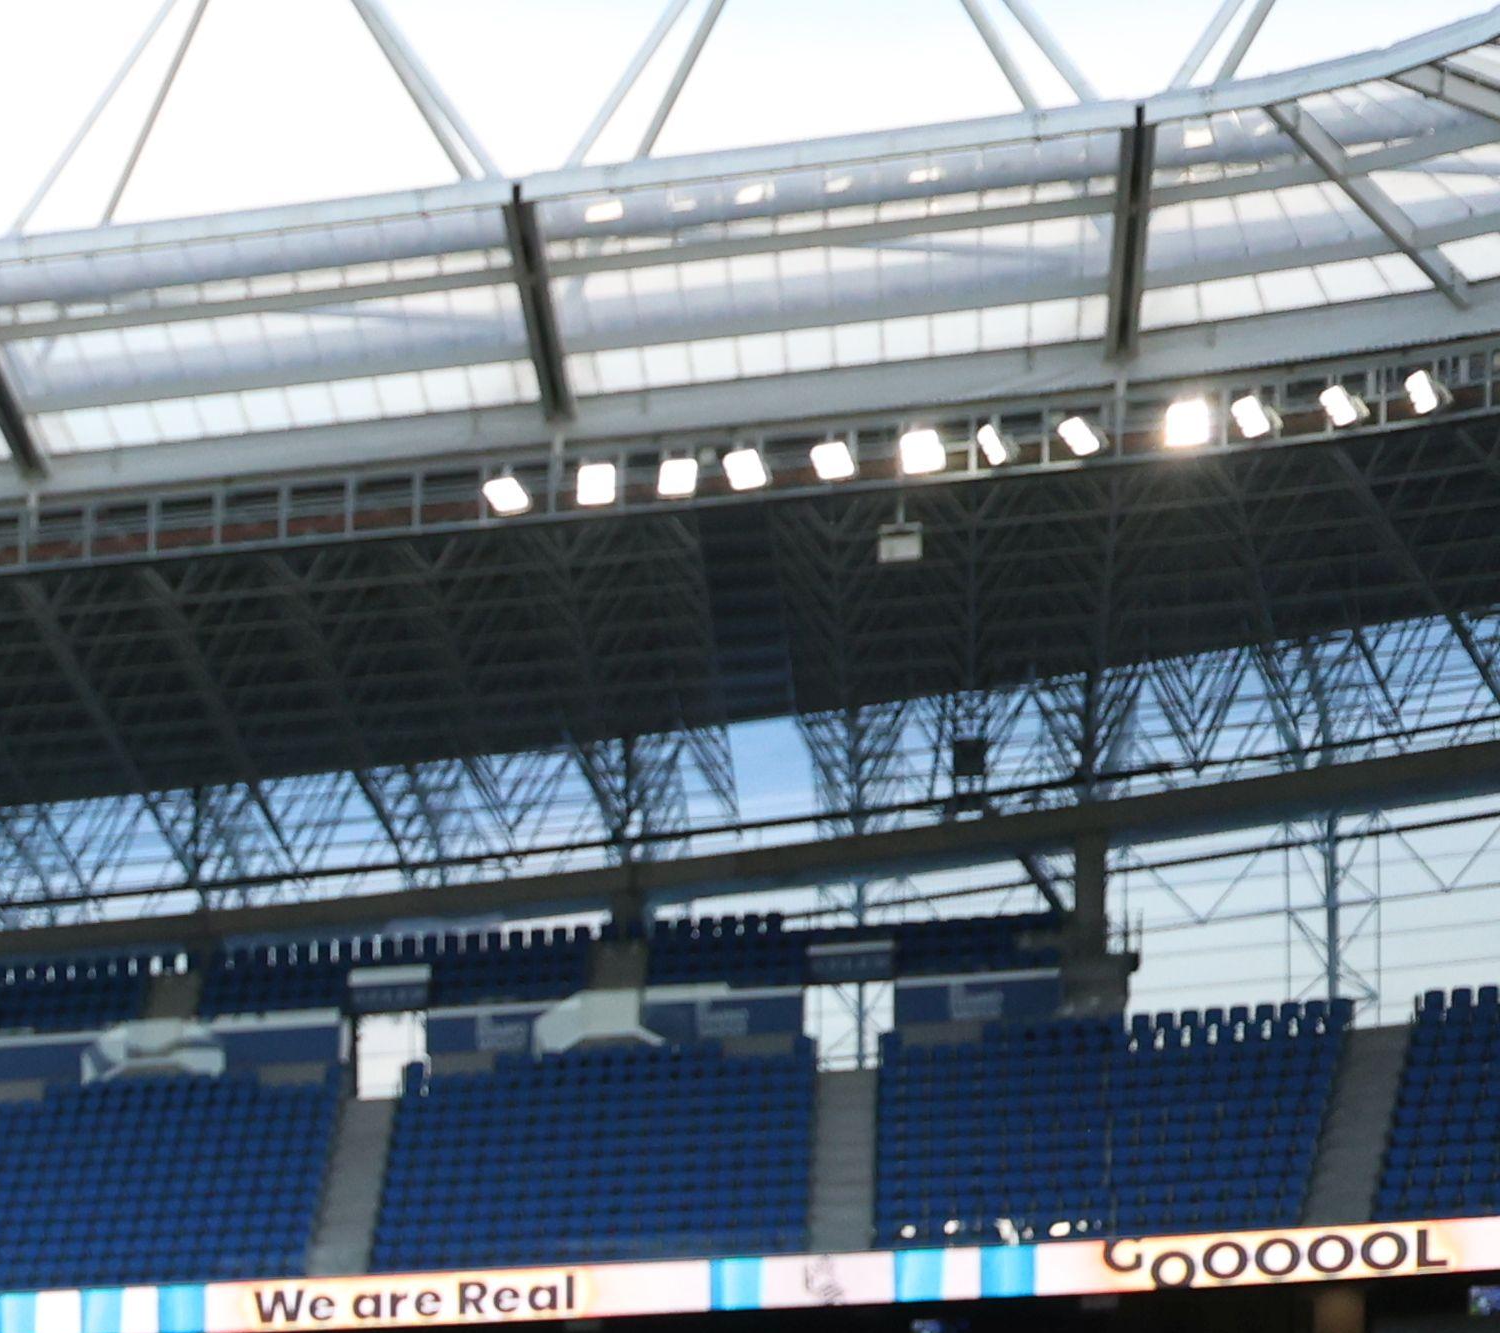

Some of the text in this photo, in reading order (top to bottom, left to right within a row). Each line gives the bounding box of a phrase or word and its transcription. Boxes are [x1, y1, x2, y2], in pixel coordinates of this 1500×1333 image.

[255, 1275, 576, 1325] We are Real
